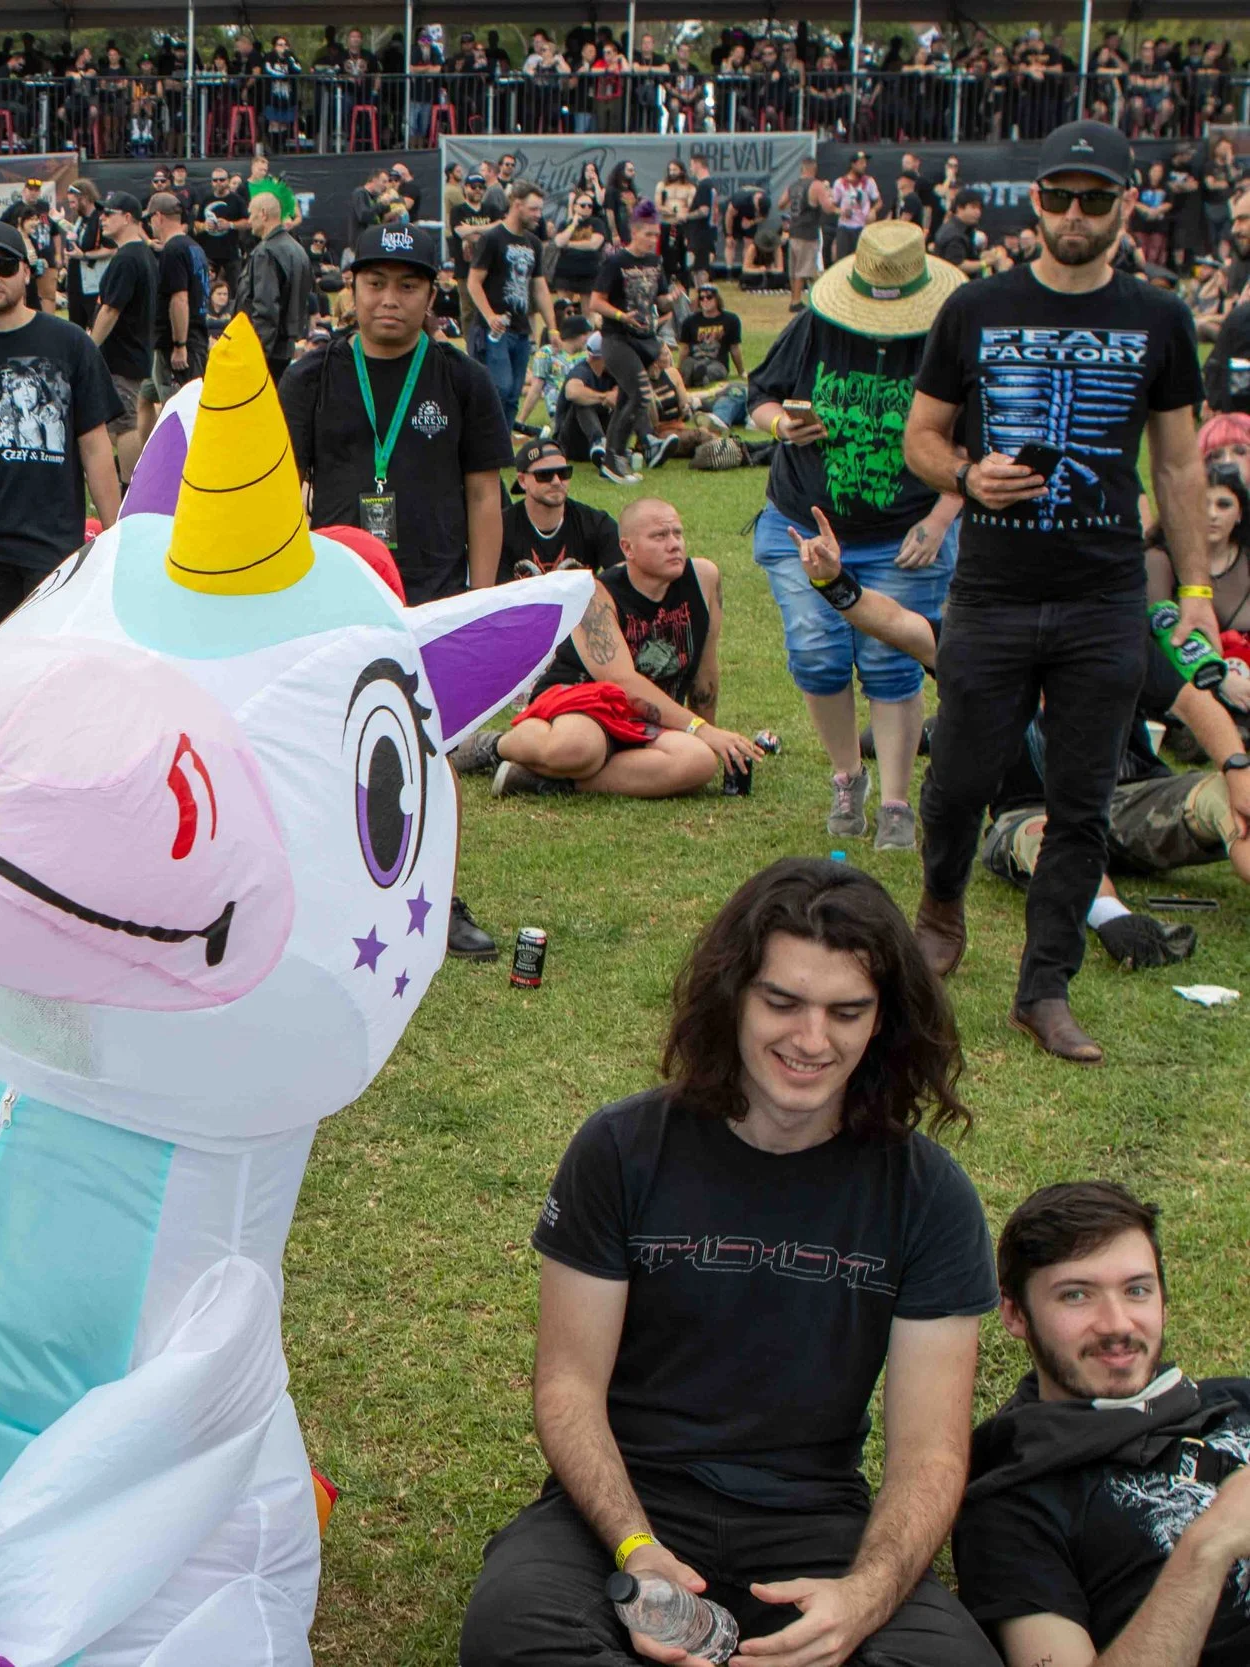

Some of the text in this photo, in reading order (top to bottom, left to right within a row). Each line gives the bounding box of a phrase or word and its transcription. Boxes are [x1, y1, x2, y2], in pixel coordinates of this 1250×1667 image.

[981, 328, 1149, 348] FEAR
[979, 345, 1147, 364] FACTORY
[30, 450, 38, 461] &
[627, 1234, 897, 1297] TOOL
